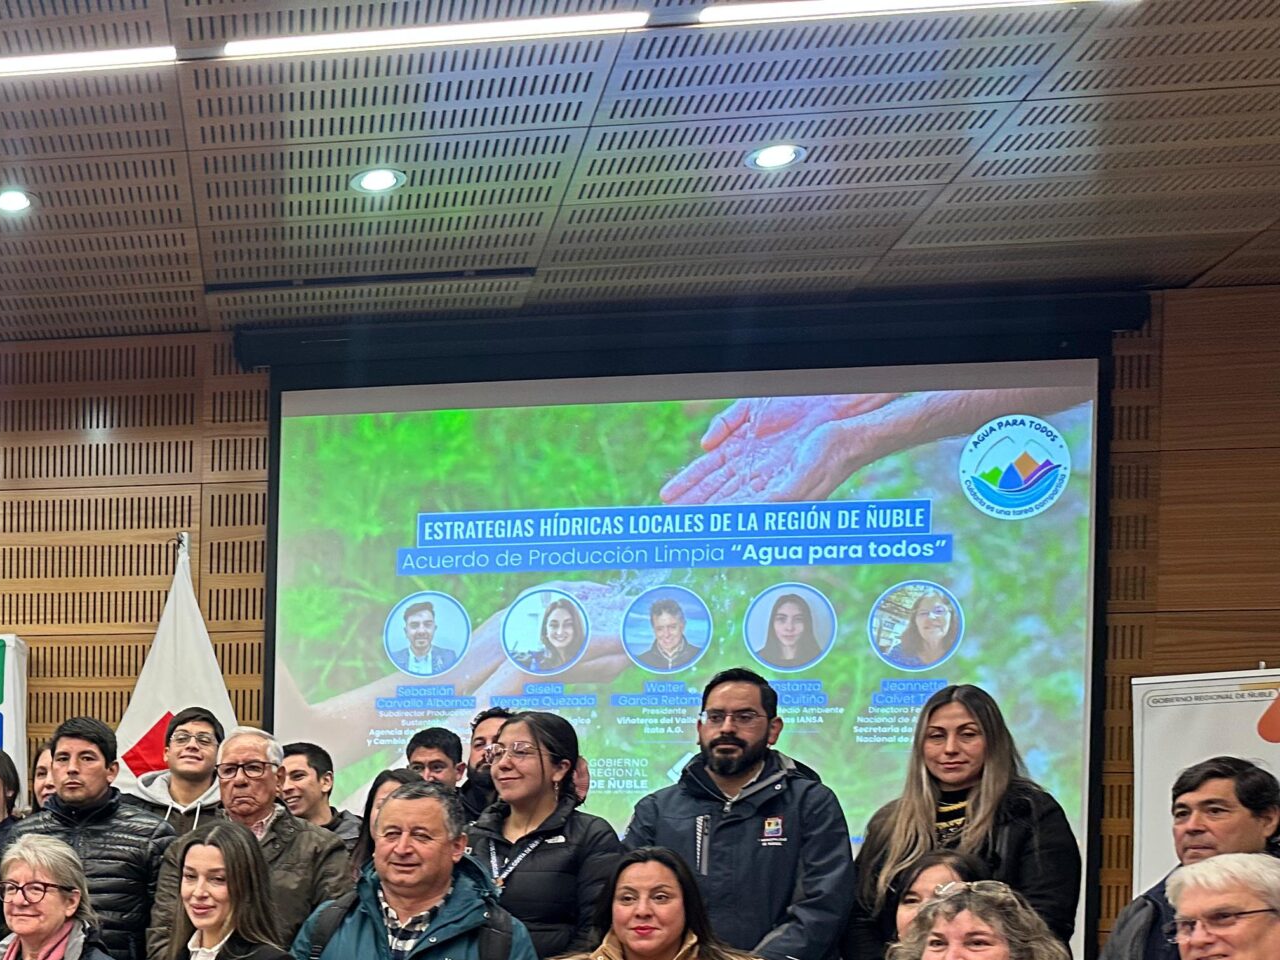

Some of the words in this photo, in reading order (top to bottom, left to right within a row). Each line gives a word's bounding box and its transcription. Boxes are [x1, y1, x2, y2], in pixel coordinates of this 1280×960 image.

[972, 426, 997, 449] AGUA
[996, 419, 1026, 430] PARA
[1029, 420, 1058, 442] TODOS
[424, 518, 534, 541] ESTRATEGIAS
[540, 512, 624, 537] HÍDRICAS
[630, 513, 704, 534] LOCALES
[710, 513, 732, 532] DE
[737, 512, 758, 531] LA
[764, 505, 831, 531] REGIÓN
[837, 510, 860, 529] DE
[866, 504, 925, 528] ÑUBLE
[402, 552, 489, 570] Acuerdo
[496, 550, 524, 567] de
[529, 546, 648, 567] Producción
[655, 544, 724, 566] Limpia
[809, 544, 862, 564] para
[525, 684, 562, 695] Gisela
[645, 682, 684, 693] Walter
[773, 682, 821, 692] nstanza
[884, 680, 945, 691] Jeannette
[398, 687, 453, 697] Sebastián
[377, 698, 423, 708] Carvallo
[426, 697, 475, 707] Albornoz
[492, 697, 539, 708] Vergara
[542, 695, 595, 706] Quezada
[661, 695, 700, 705] Retam
[782, 694, 825, 704] Cuitiño
[875, 694, 916, 704] Calvet
[868, 706, 908, 714] Directora
[616, 716, 659, 724] Viñateros
[368, 728, 402, 738] Agencia
[590, 758, 648, 767] GOBIERNO
[591, 768, 648, 777] REGIONAL
[591, 780, 604, 789] DE
[607, 777, 648, 789] ÑUBLE
